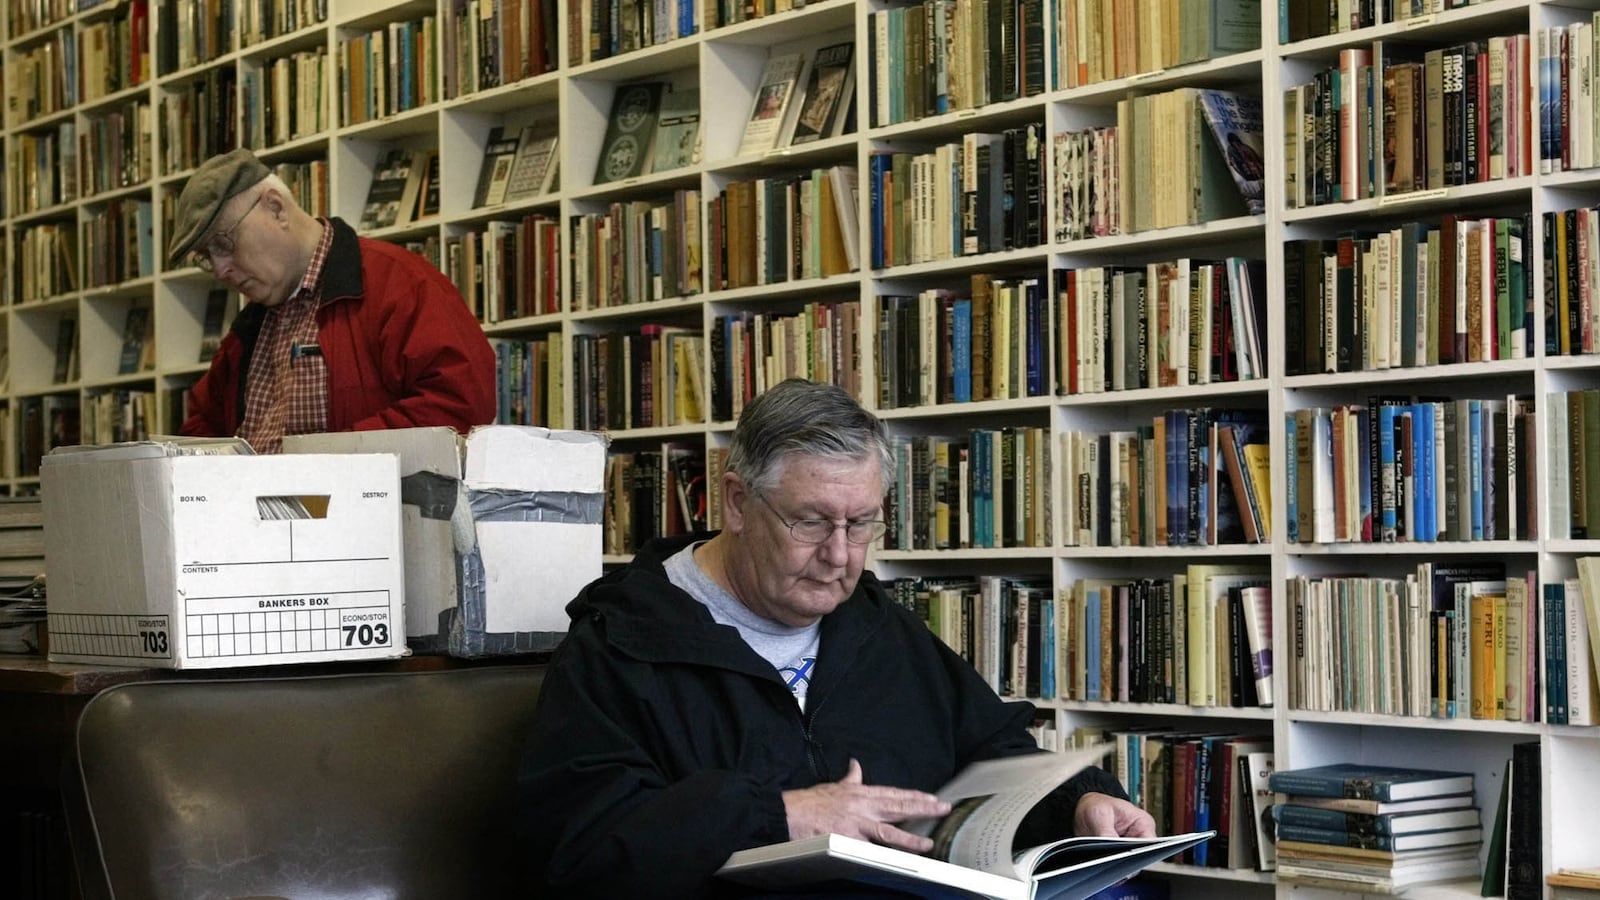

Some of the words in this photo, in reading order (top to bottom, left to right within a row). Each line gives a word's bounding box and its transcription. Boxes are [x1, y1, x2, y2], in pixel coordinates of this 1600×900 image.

[1444, 55, 1454, 93] MAYA
[1454, 54, 1464, 93] MAYA
[1467, 103, 1475, 161] CONQUISTADOR
[1497, 247, 1506, 274] GREEN
[1497, 276, 1506, 296] HELL
[1091, 291, 1099, 326] Prisoners
[1092, 328, 1099, 336] of
[1189, 449, 1198, 472] Links
[1508, 446, 1516, 477] MAYA
[258, 599, 306, 608] BANKERS
[309, 597, 329, 606] BOX
[342, 623, 388, 646] 703
[1484, 613, 1493, 648] PERU
[1570, 610, 1578, 642] BOOK
[140, 631, 168, 653] 703
[1570, 665, 1578, 700] DEAD
